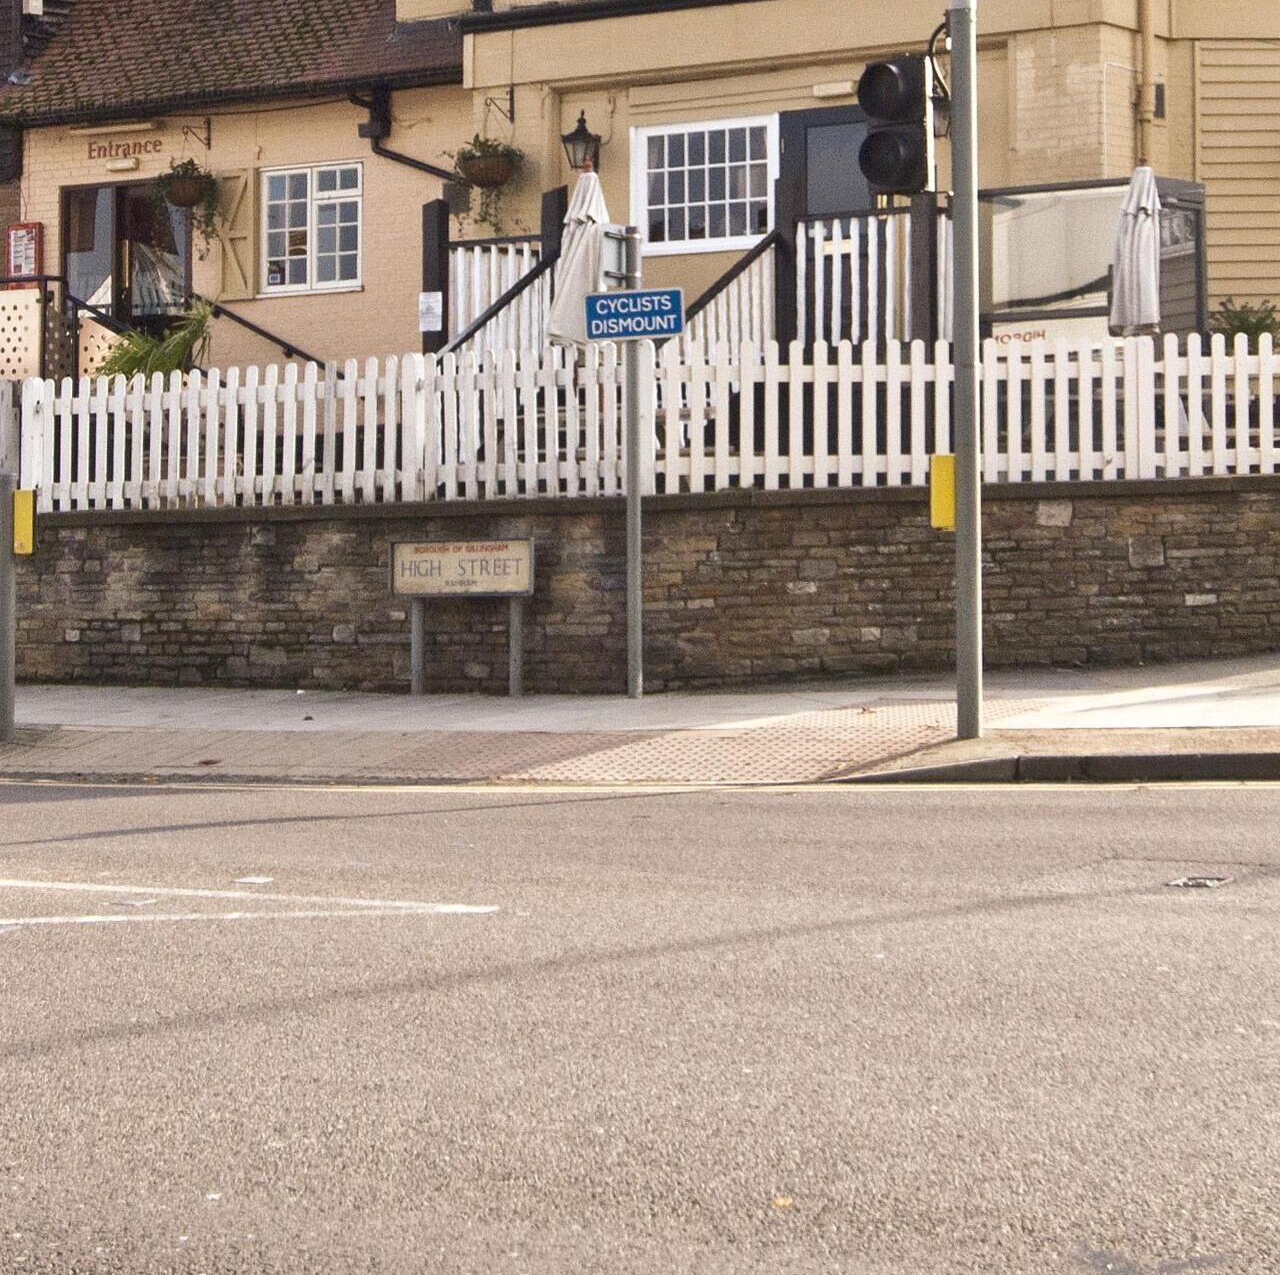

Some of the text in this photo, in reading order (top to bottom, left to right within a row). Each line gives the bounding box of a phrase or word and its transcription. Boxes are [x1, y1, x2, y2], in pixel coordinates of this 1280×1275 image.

[87, 139, 163, 159] Entrance
[596, 295, 672, 315] CYCLISTS
[591, 315, 677, 335] DISMOUNT
[414, 543, 509, 554] BOROUGH OF GILLINGHAM
[400, 557, 523, 577] HIGH STREET
